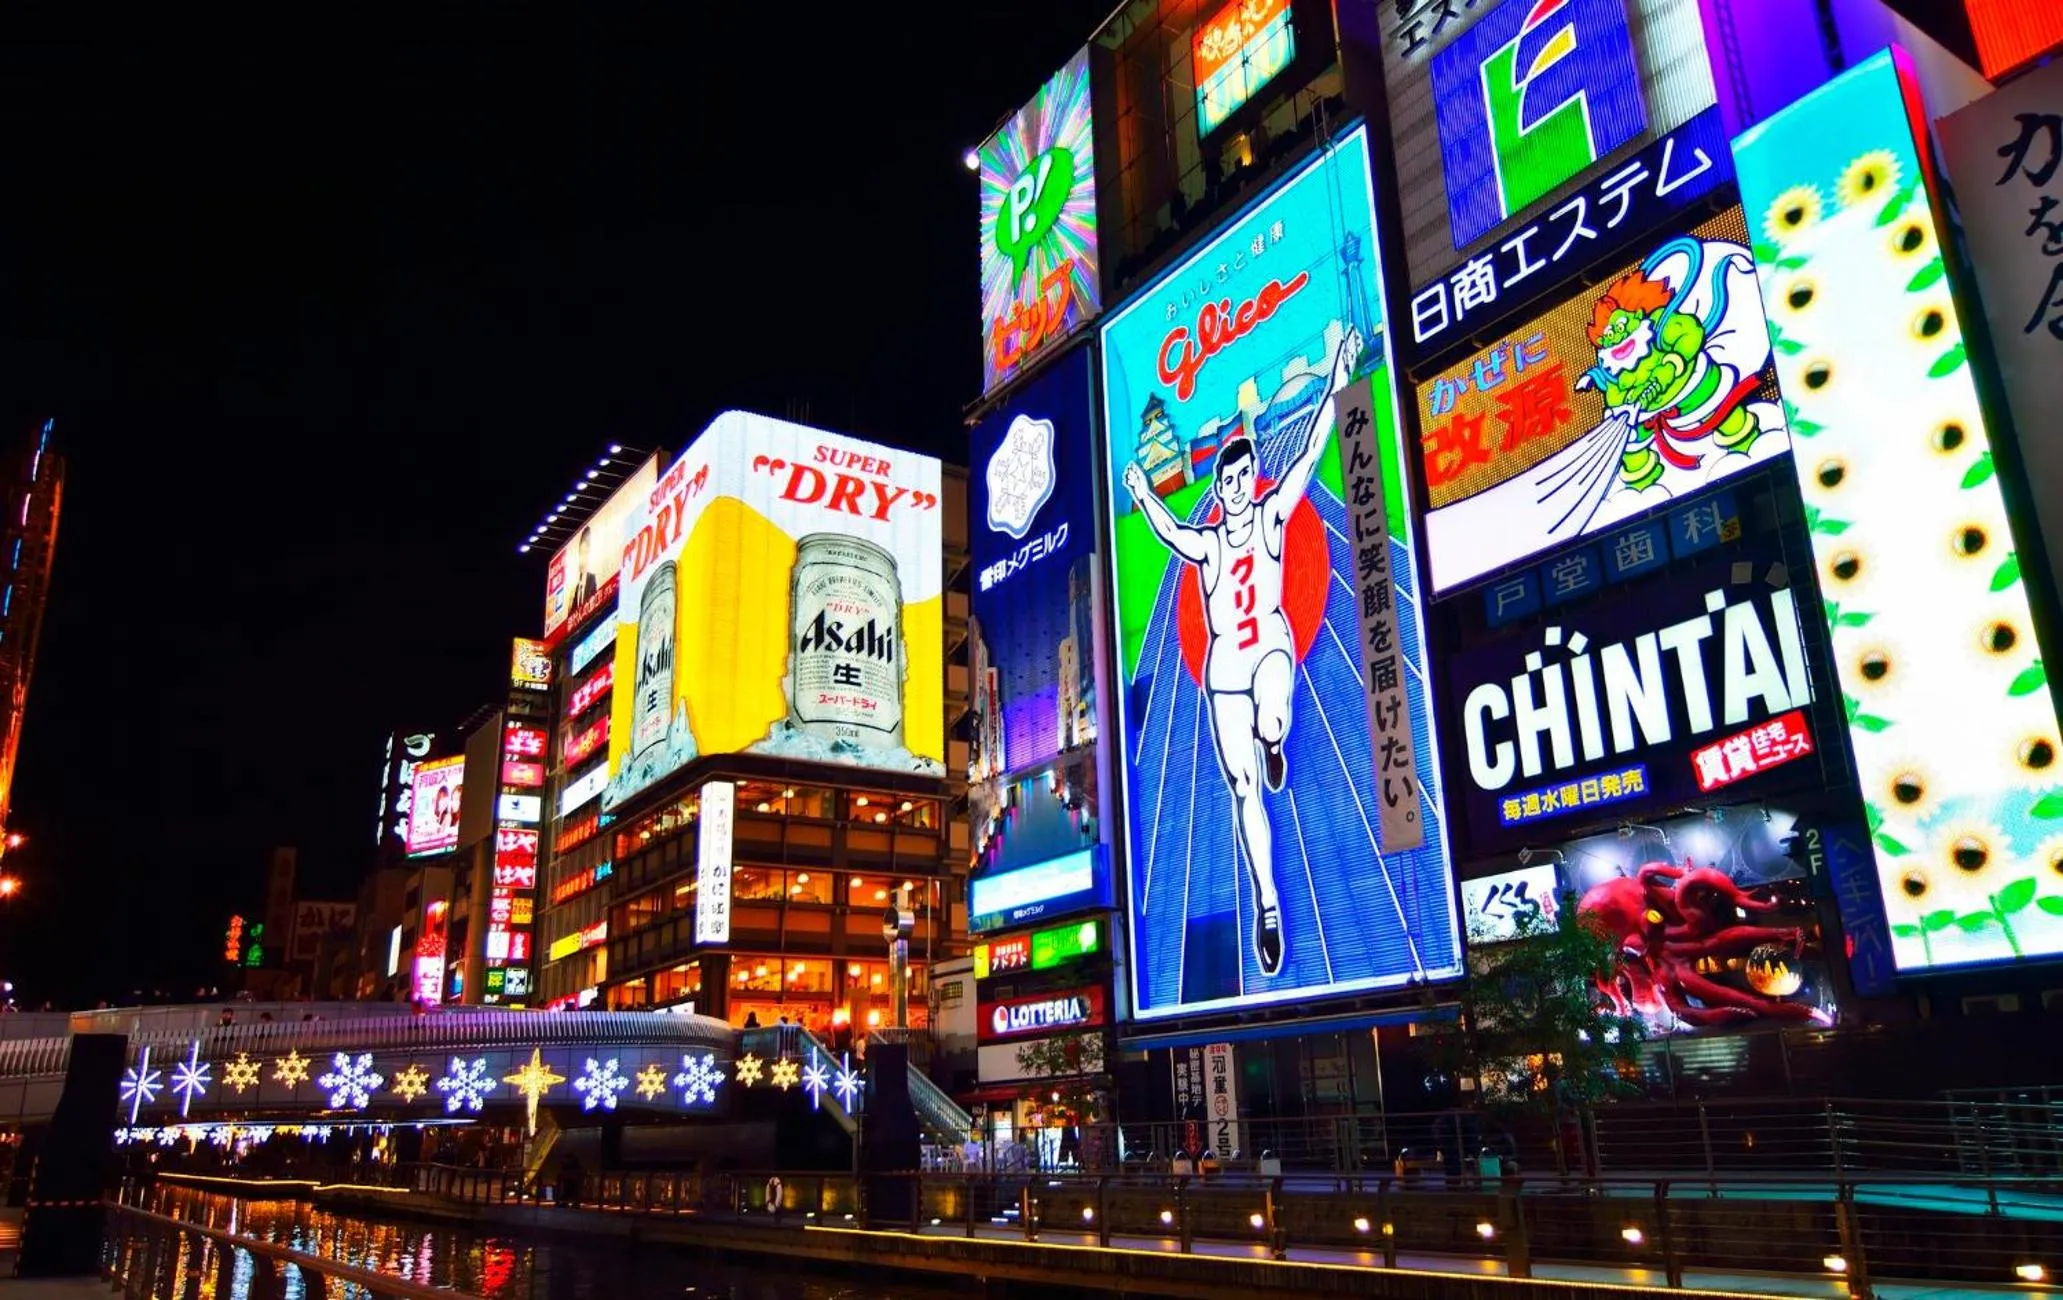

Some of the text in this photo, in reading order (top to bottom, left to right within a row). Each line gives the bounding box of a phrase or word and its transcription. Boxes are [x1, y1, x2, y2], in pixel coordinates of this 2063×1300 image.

[1400, 0, 1476, 57] エス
[1164, 219, 1287, 321] おいしさと健康
[1410, 137, 1712, 344] 日商エステム
[992, 258, 1075, 371] ピップ
[1158, 271, 1309, 400] Glico
[1428, 332, 1547, 416] かぜに
[813, 444, 892, 477] SUPER
[1421, 361, 1573, 487] 改源
[979, 521, 1068, 592] 雪印メグミルク
[1494, 501, 1724, 617] 戸堂歯科
[801, 609, 892, 664] Asahi
[1228, 547, 1260, 651] グリコ
[1342, 406, 1415, 823] みんなに笑顔を届けたい。
[818, 693, 877, 710] スーパードライ
[833, 663, 862, 687] 生
[1757, 733, 1810, 766] ニュース
[1503, 769, 1645, 821] 毎週水曜日発売
[1010, 997, 1081, 1028] LOTTERIA
